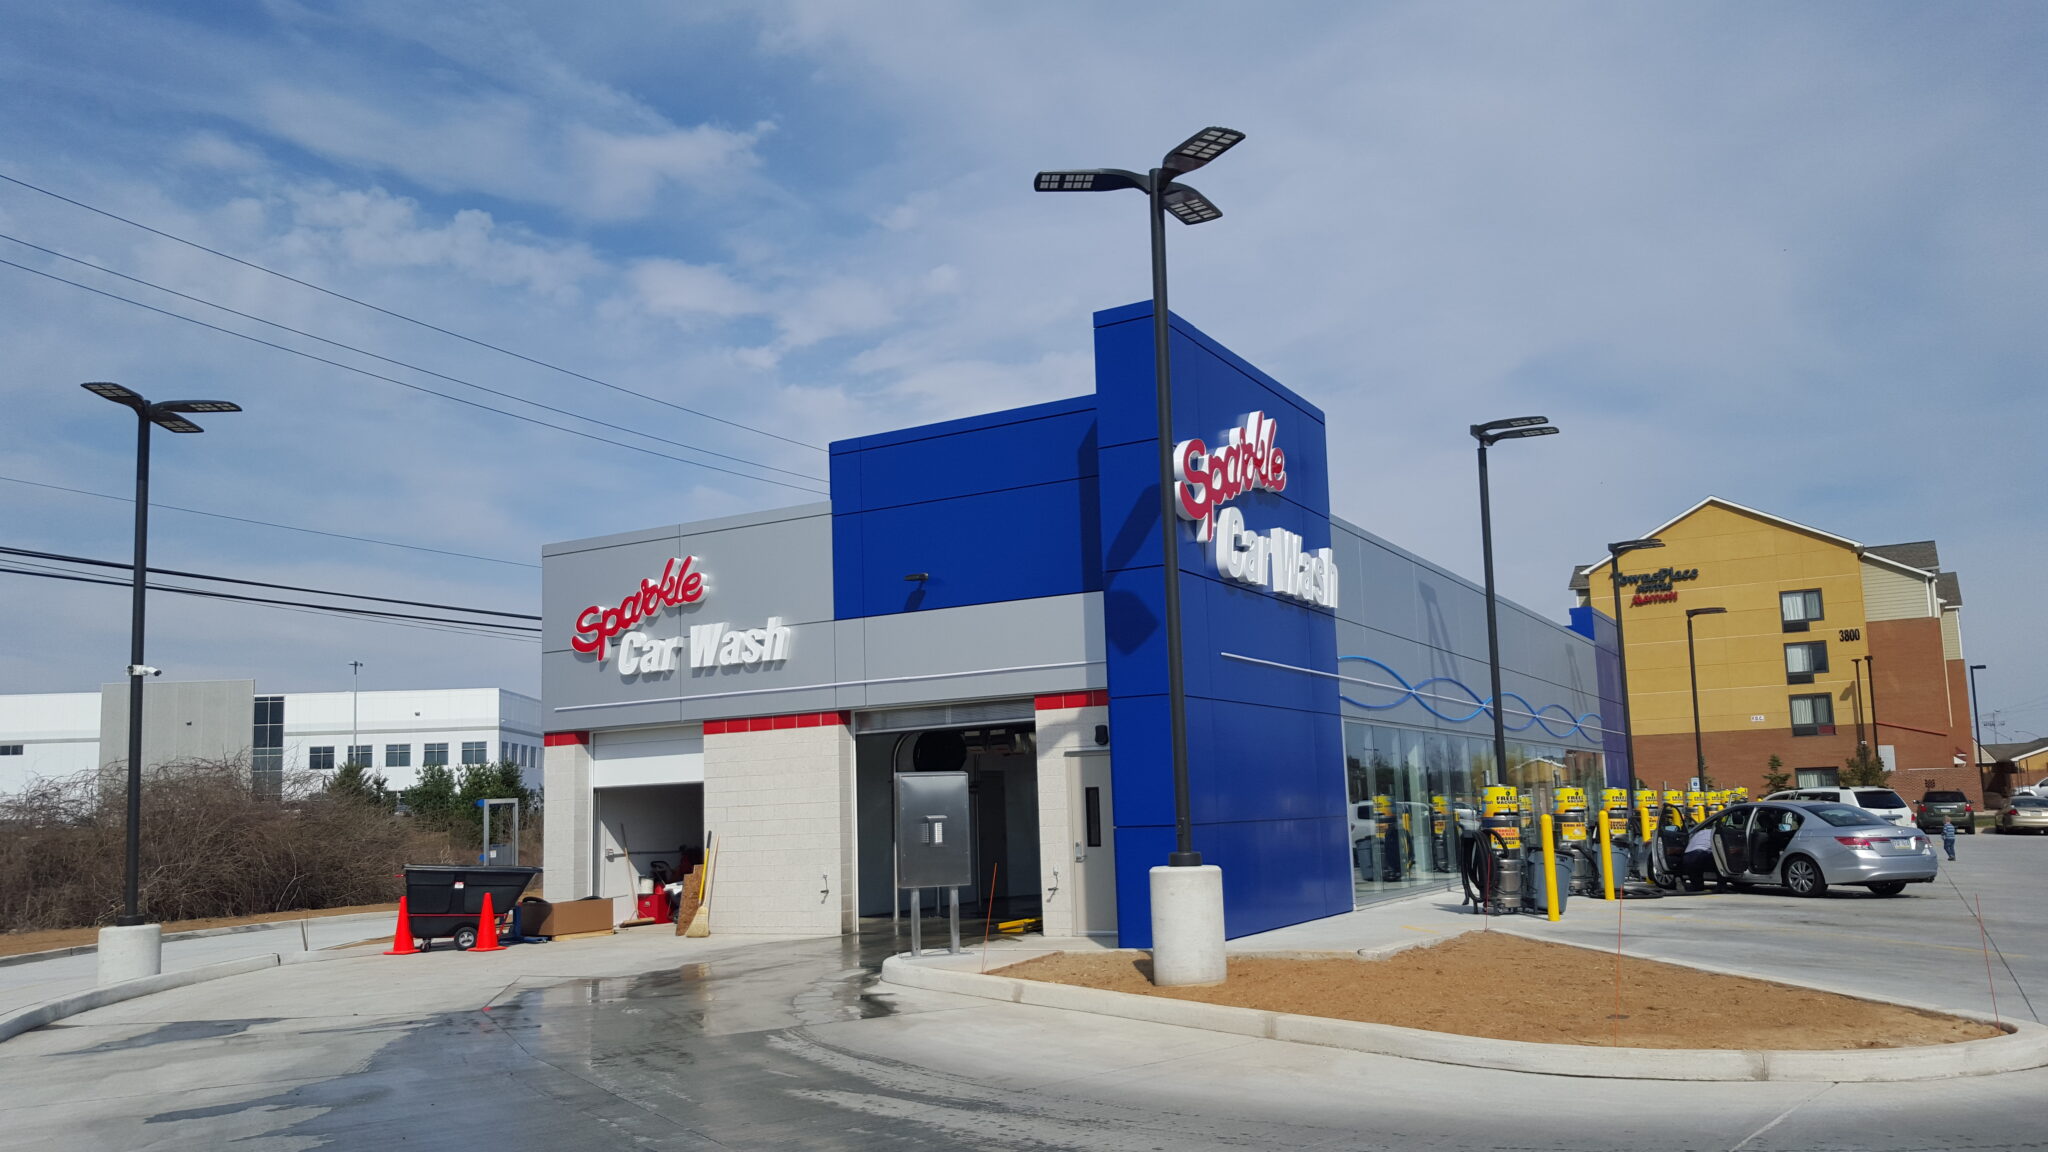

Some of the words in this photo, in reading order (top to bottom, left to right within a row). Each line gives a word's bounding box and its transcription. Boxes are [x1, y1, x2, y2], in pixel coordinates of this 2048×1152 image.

[1173, 410, 1287, 542] Sparkle
[571, 555, 710, 662] Sparkle
[1216, 506, 1268, 586] Car
[1270, 527, 1338, 609] Wash
[618, 631, 684, 676] Car
[690, 616, 791, 668] Wash
[1839, 629, 1860, 642] 3800
